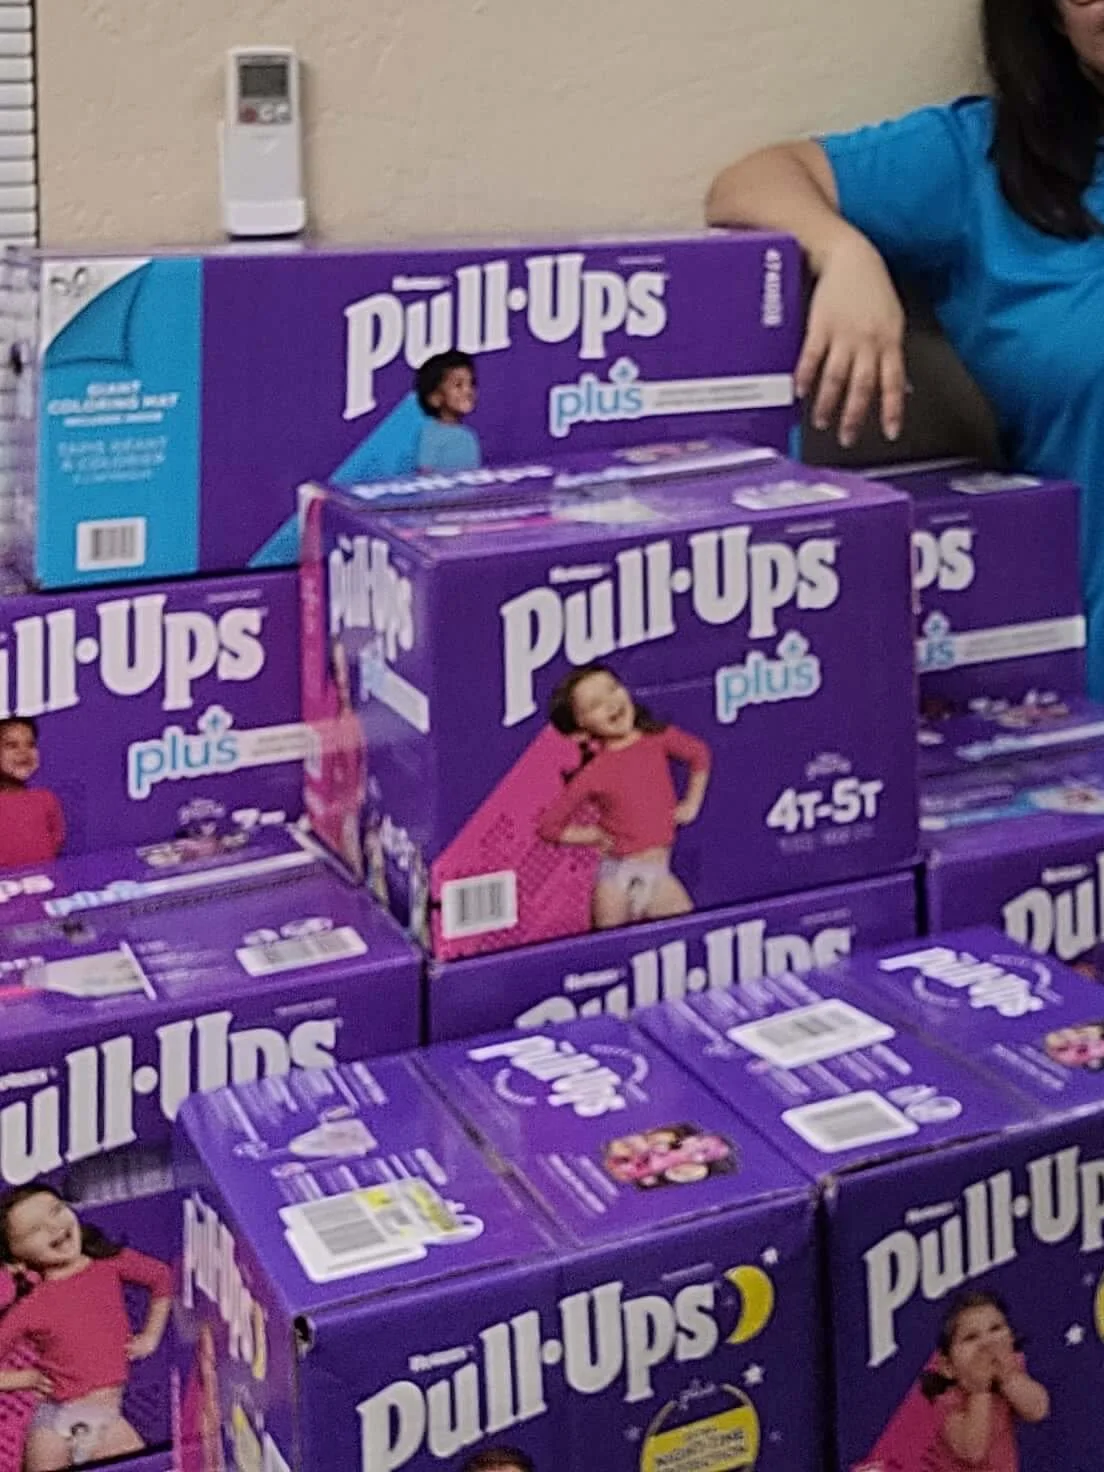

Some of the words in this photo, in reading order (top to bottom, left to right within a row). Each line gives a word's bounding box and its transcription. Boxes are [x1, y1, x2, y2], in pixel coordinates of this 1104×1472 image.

[555, 373, 644, 432] plus
[722, 653, 815, 714] plus
[135, 730, 239, 790] plus
[766, 778, 885, 833] 4T-5T
